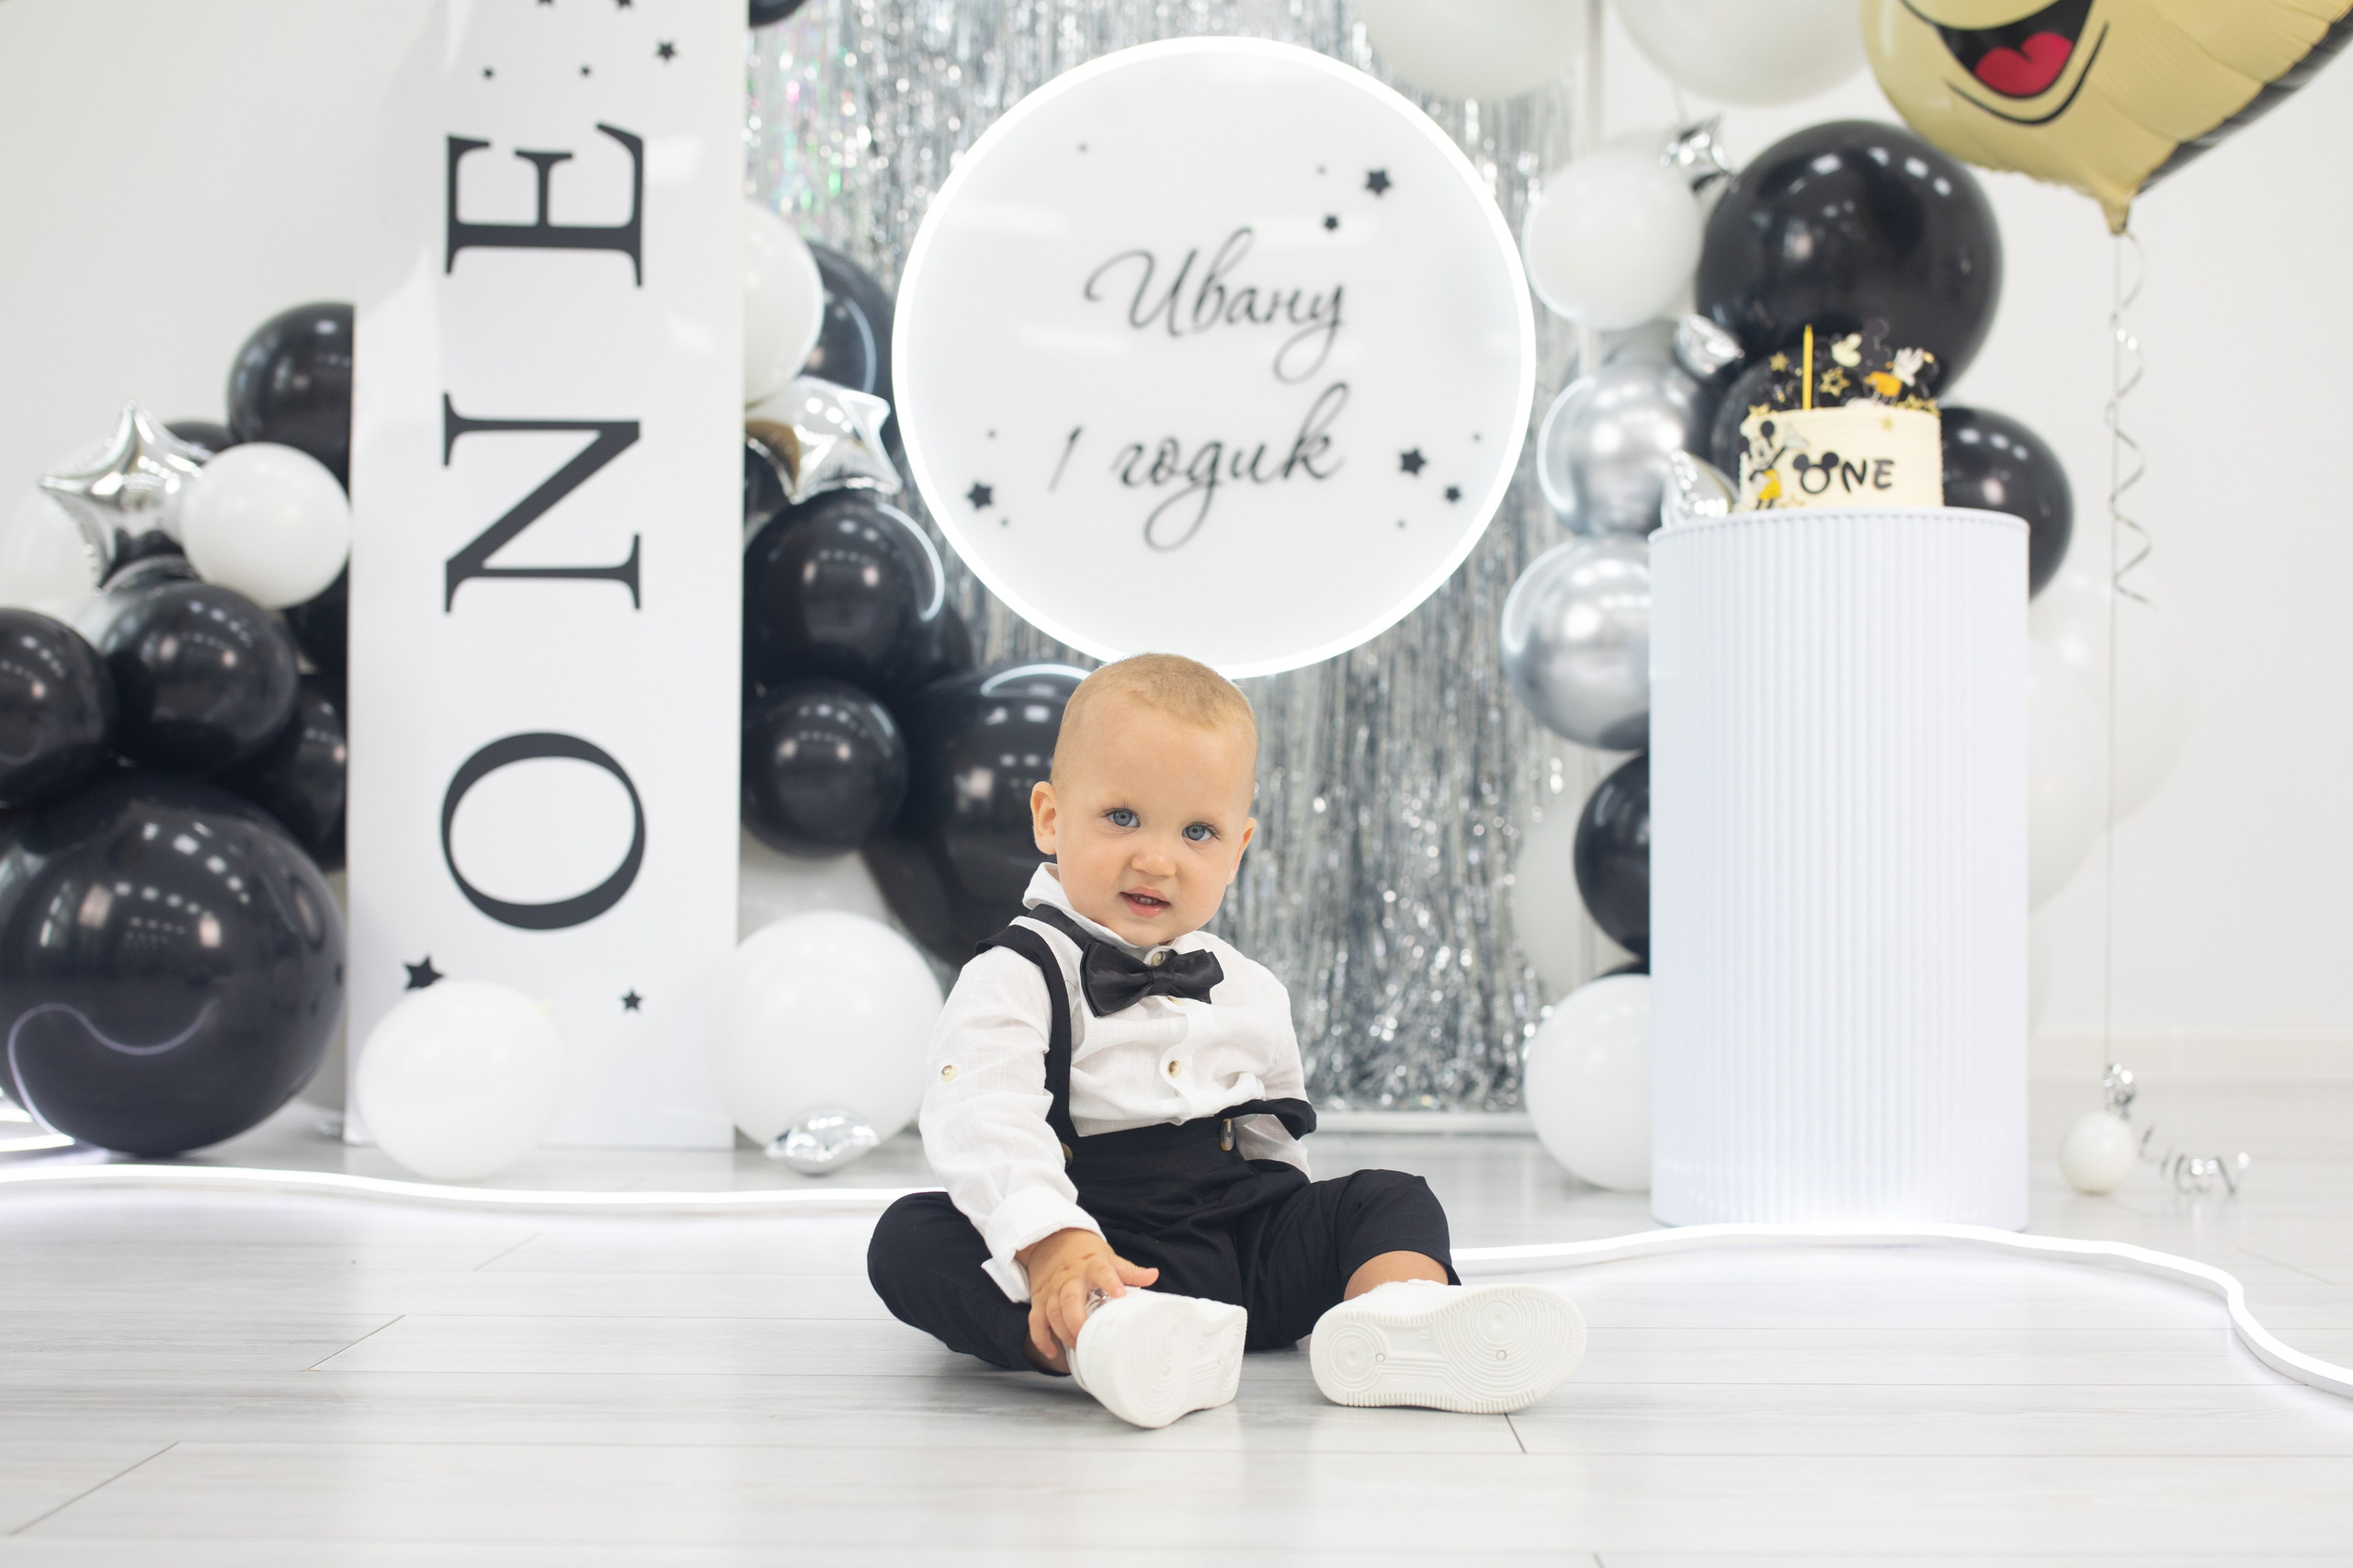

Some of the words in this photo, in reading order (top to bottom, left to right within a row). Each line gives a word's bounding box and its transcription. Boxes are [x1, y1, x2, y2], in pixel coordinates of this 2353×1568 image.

[1084, 227, 1346, 381] Ивану
[441, 122, 645, 930] ONE
[1050, 426, 1083, 492] 1
[1112, 382, 1349, 551] годик
[1793, 451, 1894, 494] ONE
